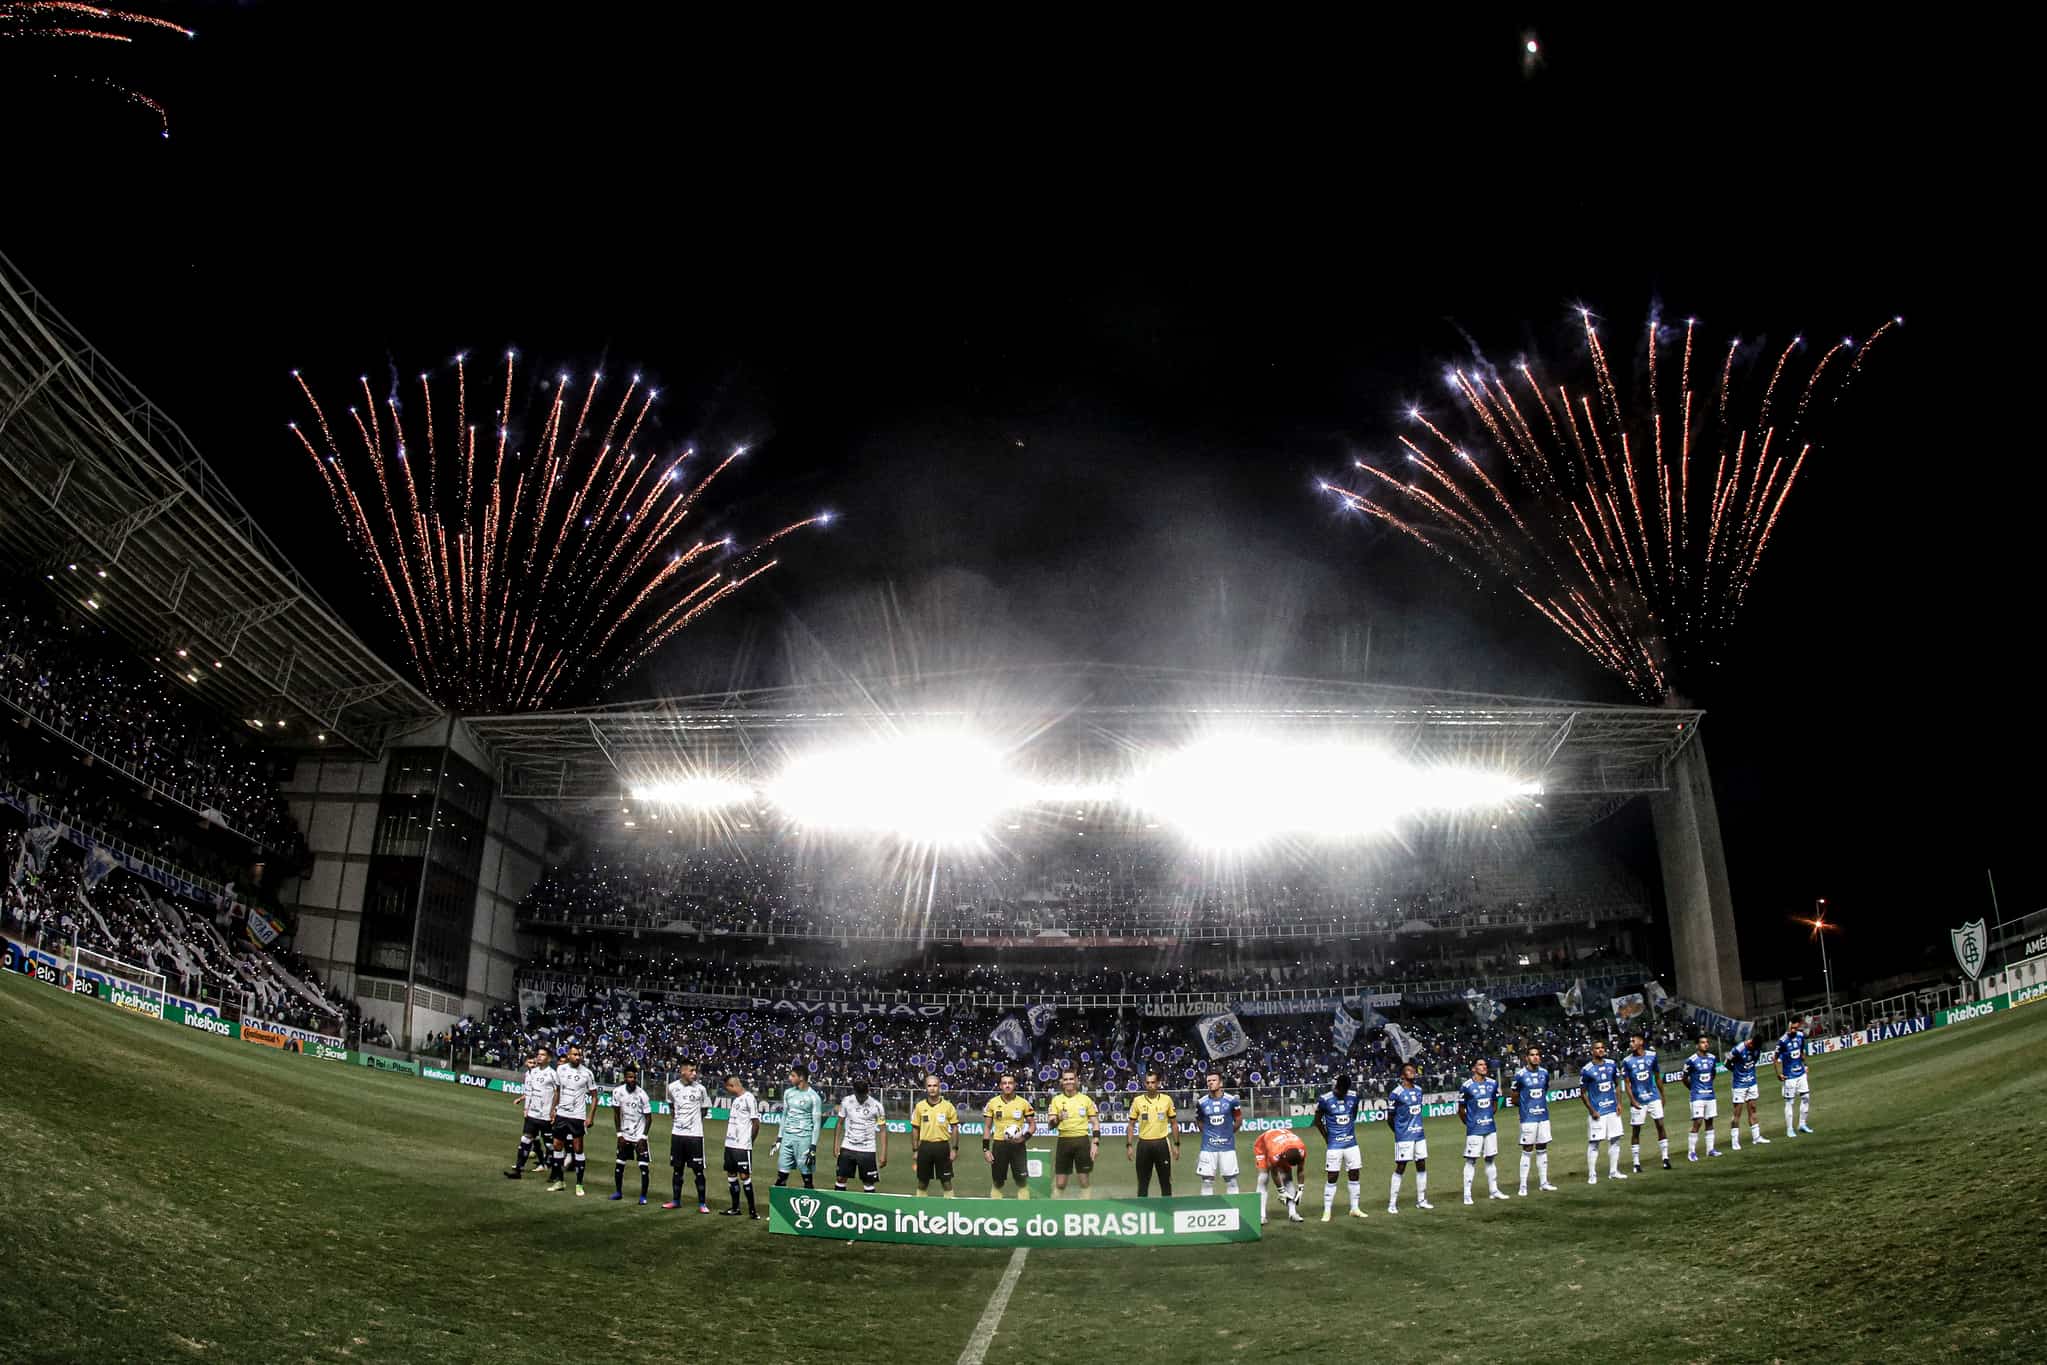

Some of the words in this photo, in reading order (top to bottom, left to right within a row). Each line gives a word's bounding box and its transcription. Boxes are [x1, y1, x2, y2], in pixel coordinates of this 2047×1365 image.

[1144, 1001, 1231, 1017] CACHAZEIROS
[1946, 1001, 1994, 1024] intelbras
[184, 1009, 230, 1035] intelbras
[1871, 1017, 1926, 1042] HAVAN
[459, 1074, 486, 1088] SOLAR
[826, 1205, 888, 1234] Copa
[895, 1208, 1019, 1237] intelbras
[1026, 1213, 1058, 1237] do
[1064, 1211, 1165, 1237] BRASIL
[1186, 1214, 1227, 1229] 2022
